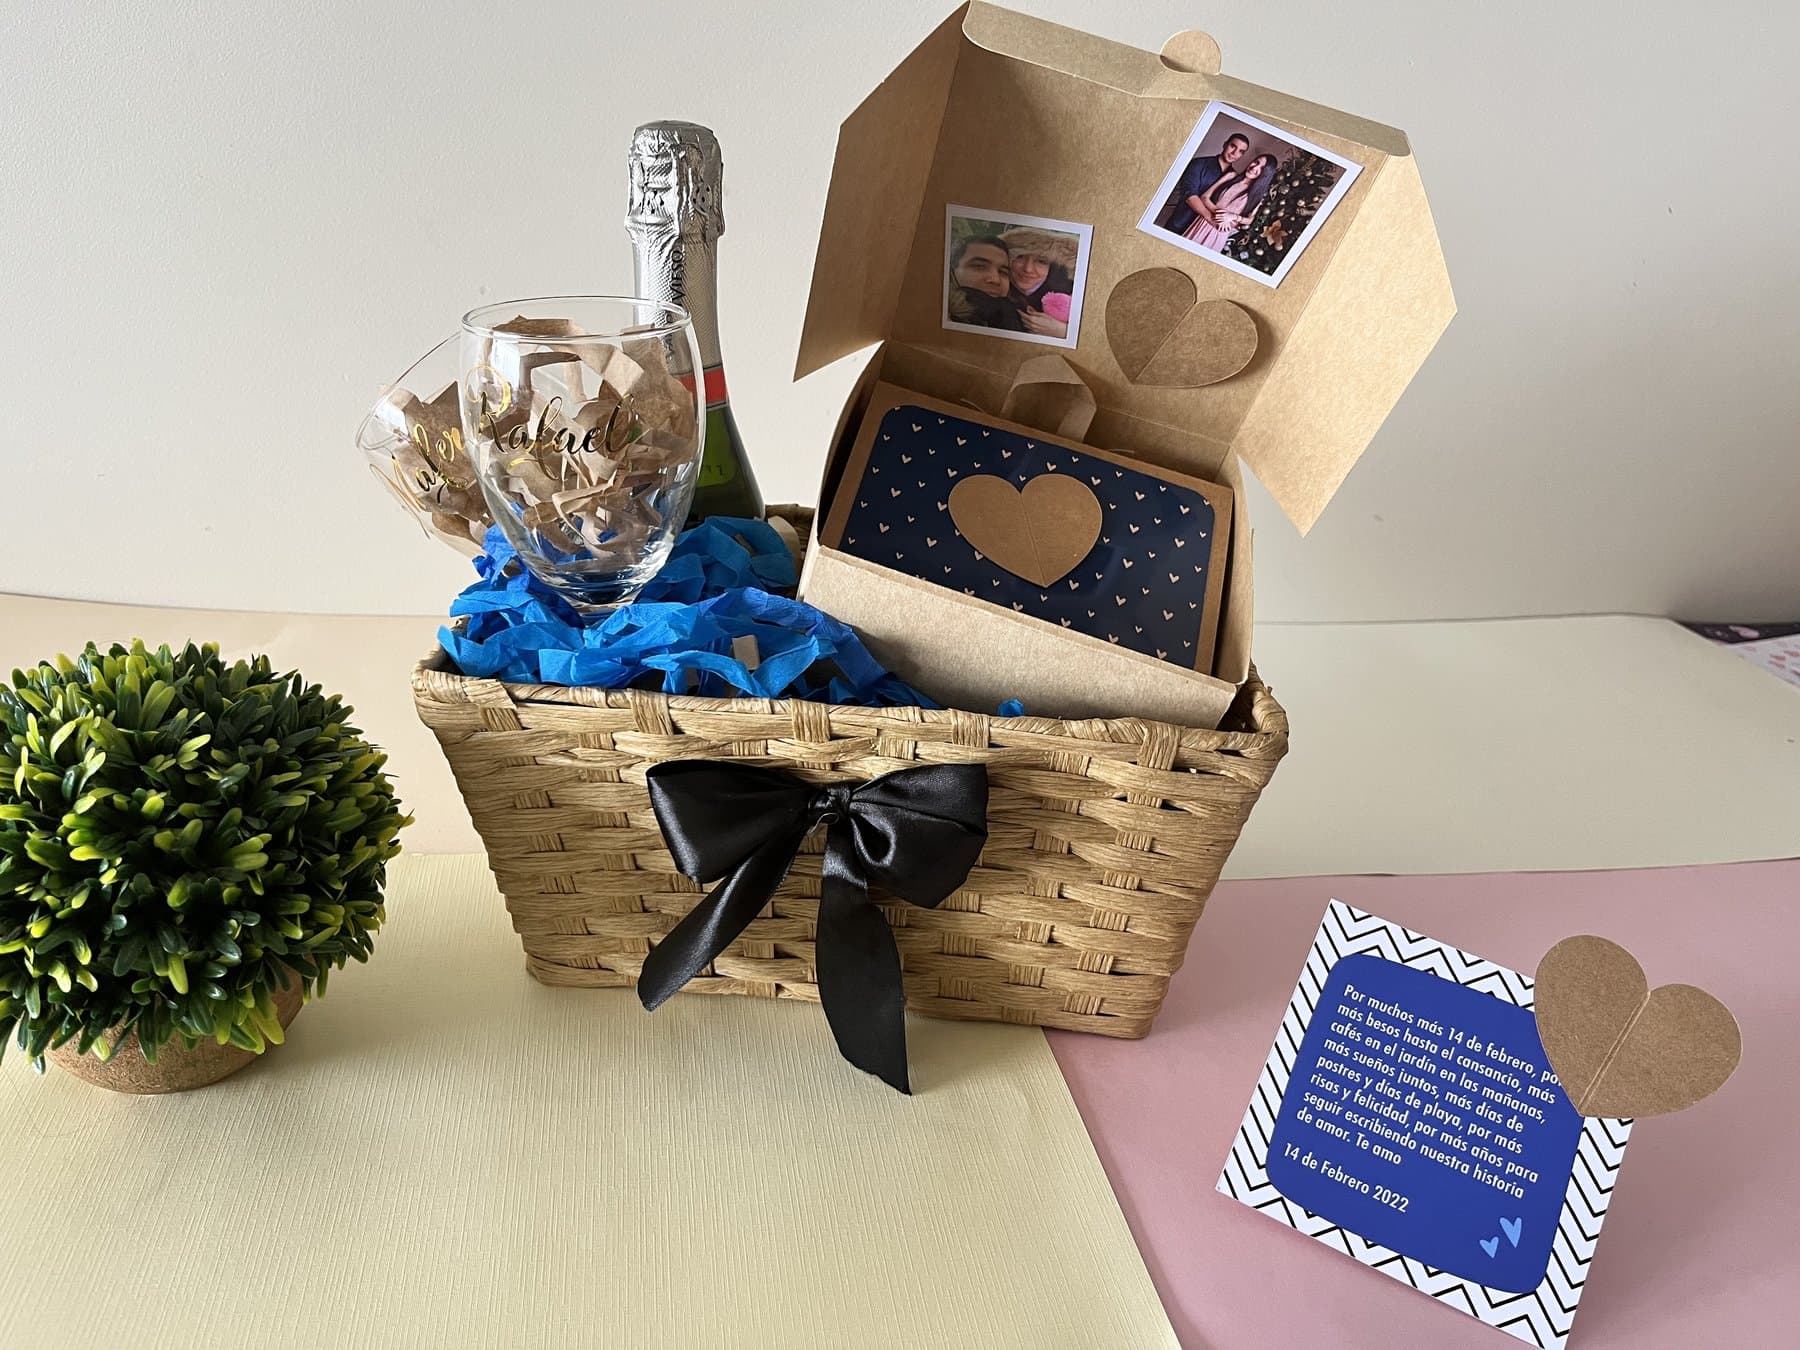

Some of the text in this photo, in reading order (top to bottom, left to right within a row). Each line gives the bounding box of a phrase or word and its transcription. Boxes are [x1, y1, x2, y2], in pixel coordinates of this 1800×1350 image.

[465, 365, 644, 480] Rafael
[1330, 1021, 1546, 1125] cafés en el jardín en las mañanas,
[1337, 1004, 1556, 1105] más besos hasta el cansancio, más
[1343, 984, 1367, 1003] Por
[1367, 997, 1415, 1024] muchos
[1416, 1018, 1444, 1037] más
[1448, 1027, 1464, 1045] 14
[1466, 1035, 1483, 1053] de
[1485, 1042, 1537, 1079] febrero,
[1296, 1106, 1402, 1165] de amor. Te amo
[1310, 1073, 1539, 1184] risas y felicidad, por más años para
[1315, 1055, 1523, 1155] postres y días de playa, por más
[1323, 1038, 1524, 1133] más sueños juntos, más días de
[1284, 1142, 1410, 1214] 14 de Febrero 2022
[1303, 1091, 1525, 1199] seguir escribiendo nuestra historia
